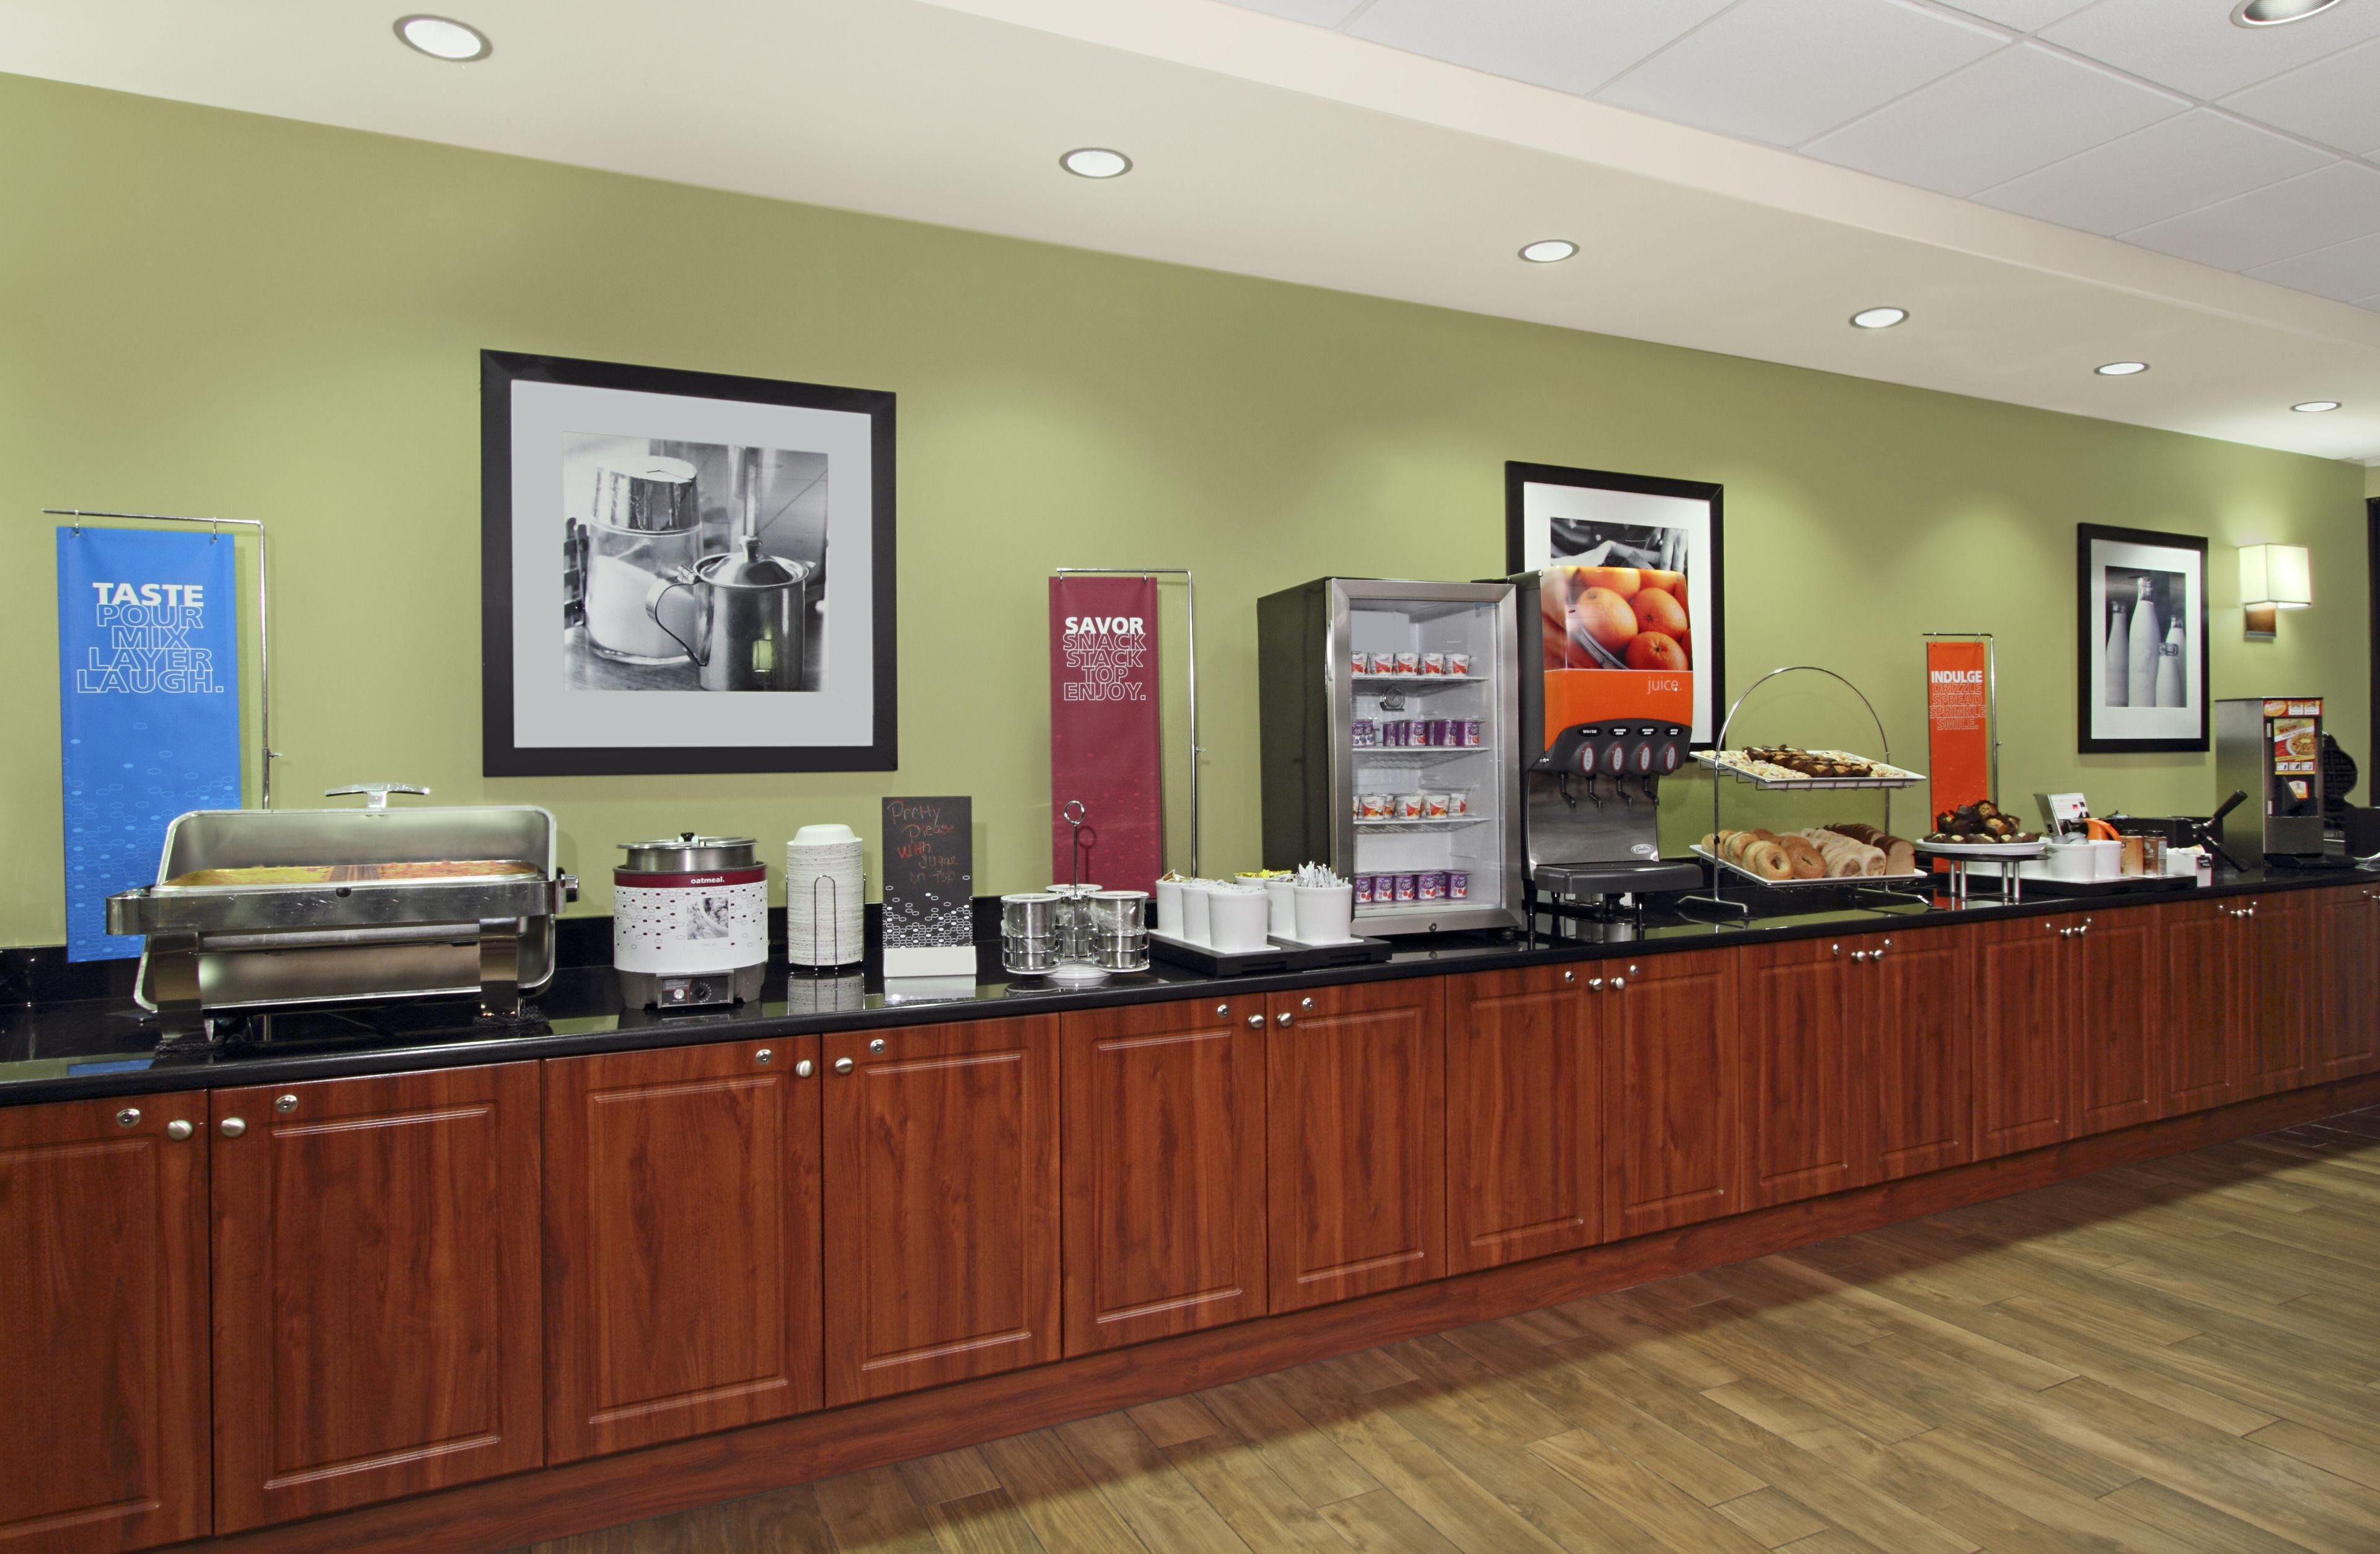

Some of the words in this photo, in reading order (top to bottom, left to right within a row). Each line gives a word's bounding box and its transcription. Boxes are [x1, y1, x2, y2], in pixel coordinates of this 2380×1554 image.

[92, 582, 204, 607] TASTE
[97, 603, 204, 628] POUR
[1065, 617, 1144, 634] SAVOR
[112, 626, 190, 649] MIX
[1062, 633, 1147, 651] SNACK
[89, 648, 213, 671] LAYER
[1066, 649, 1144, 667] STACK
[77, 669, 224, 693] LAUGH.
[1082, 665, 1129, 684] TOP
[1931, 670, 1983, 683] INDULGE
[1064, 682, 1146, 701] ENJOY.
[1647, 676, 1681, 695] juice.
[1933, 682, 1982, 695] DRIZZLE
[1933, 693, 1983, 706] SPREAD
[1928, 705, 1987, 719] SPRINKLE
[1936, 716, 1979, 731] SMILE.
[887, 799, 941, 826] Pretty
[690, 876, 725, 884] oatmeal.
